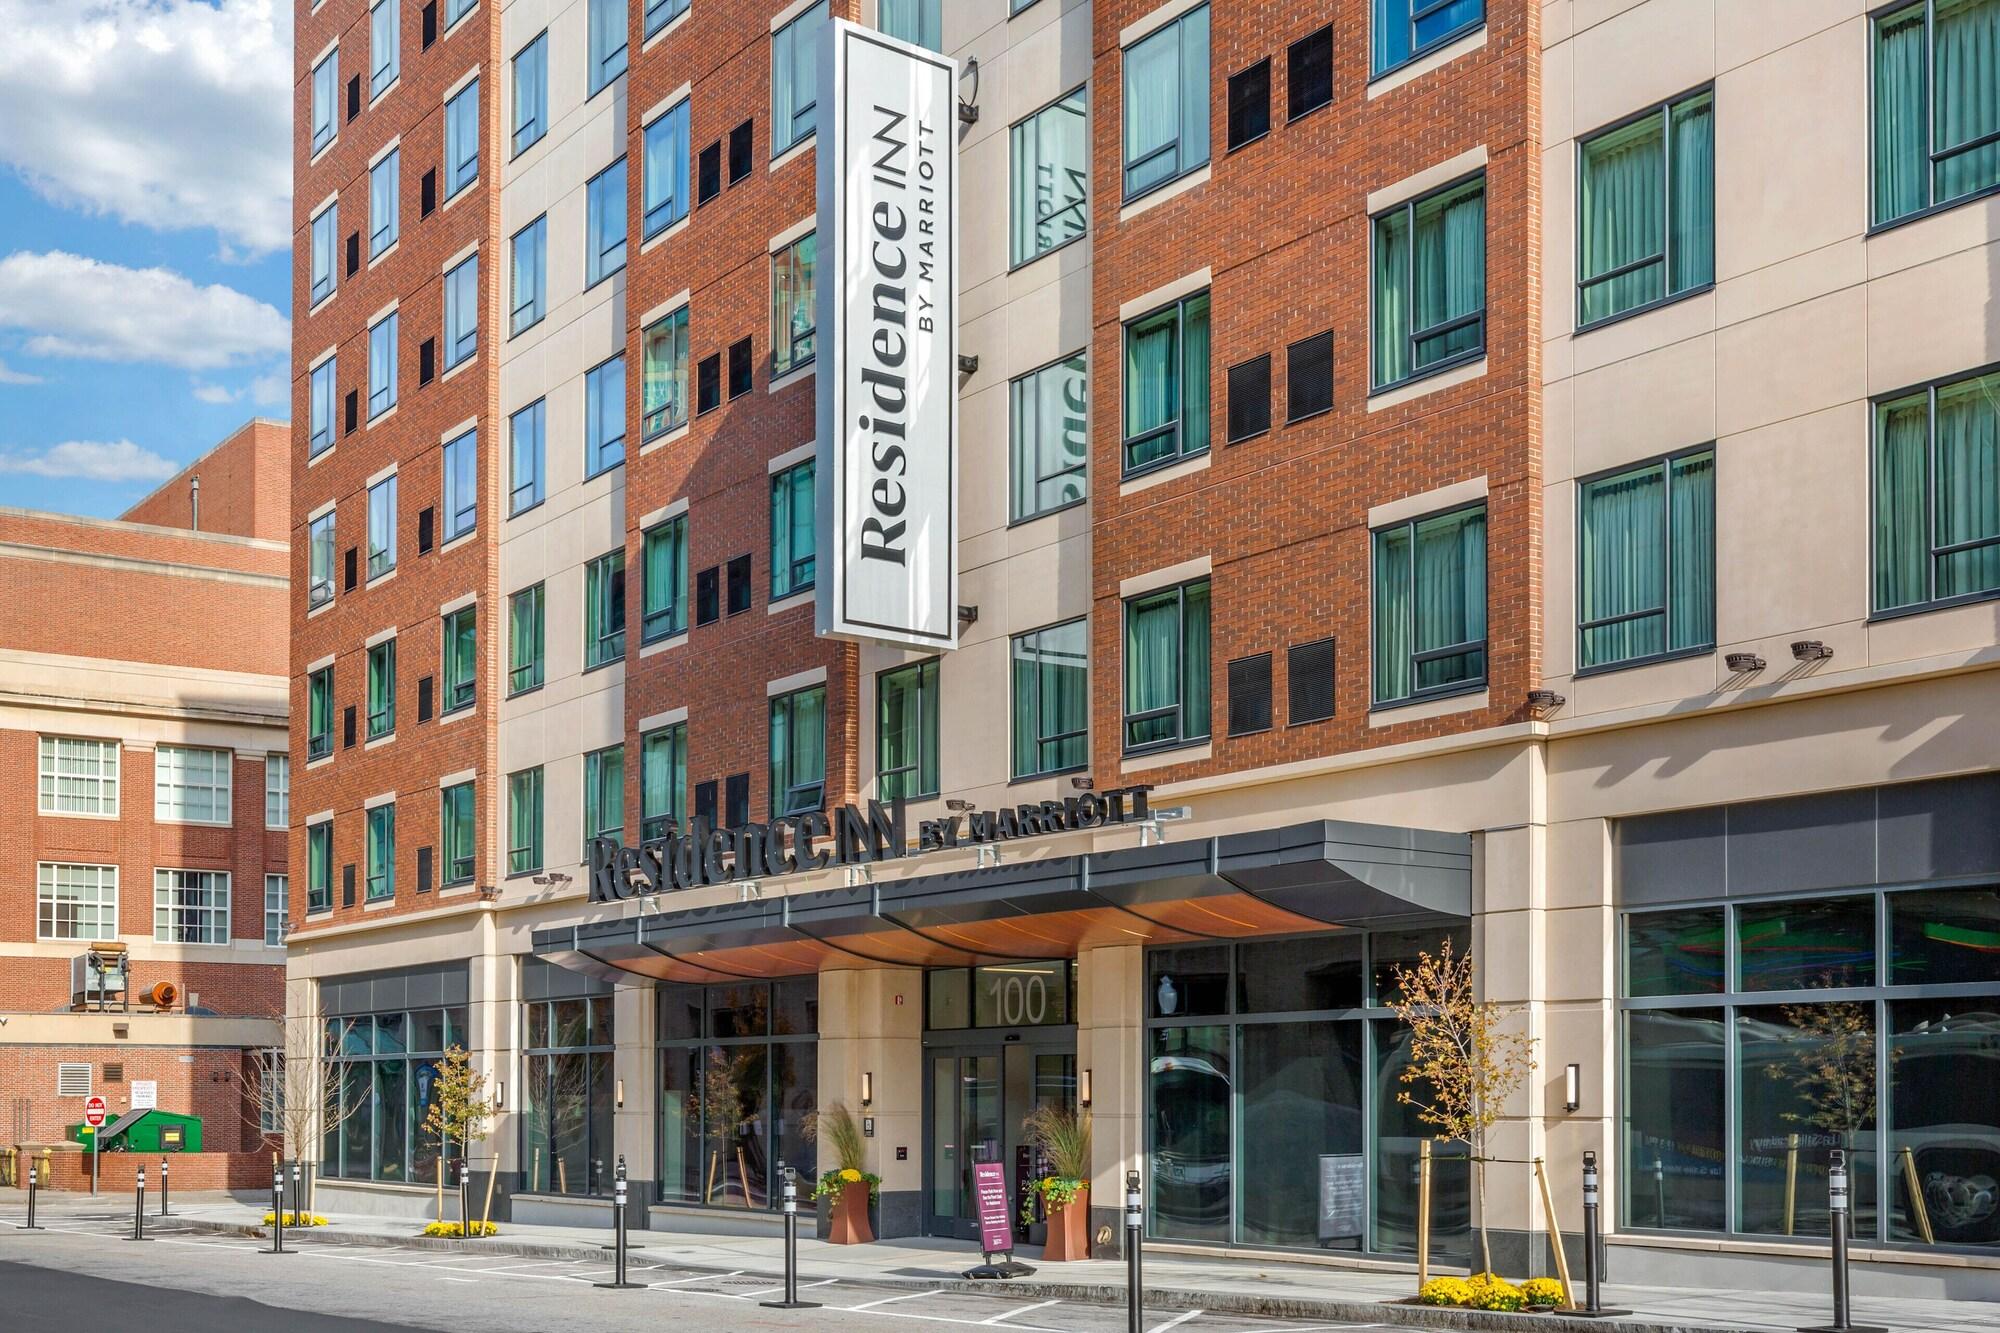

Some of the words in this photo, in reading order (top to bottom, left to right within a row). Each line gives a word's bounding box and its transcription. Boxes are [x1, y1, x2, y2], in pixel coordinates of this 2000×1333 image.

[872, 104, 907, 189] INN
[919, 119, 934, 282] MARRIOTT
[919, 294, 934, 333] BY
[859, 201, 907, 568] Residence
[587, 811, 831, 904] Residence
[835, 796, 906, 864] INN
[919, 816, 963, 850] BY
[969, 784, 1154, 843] MARRIOTT
[990, 975, 1046, 1025] 100
